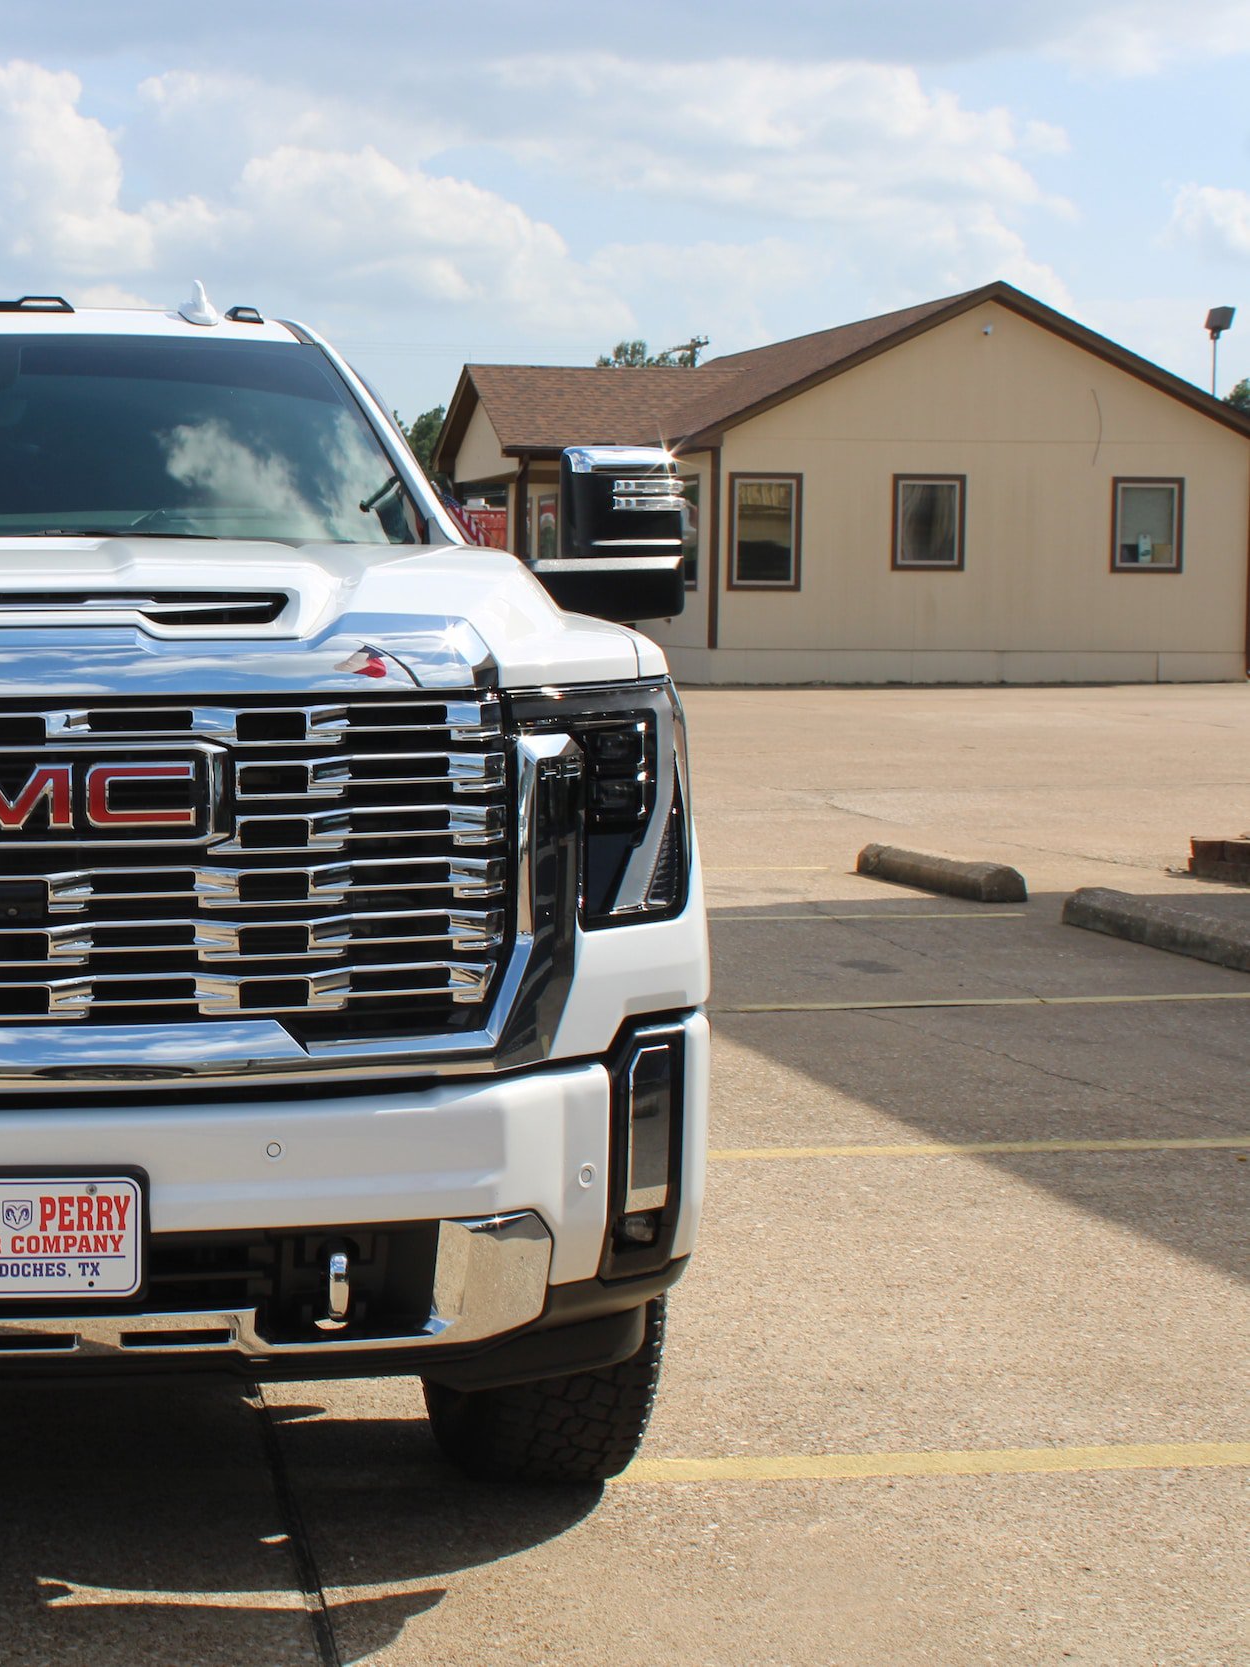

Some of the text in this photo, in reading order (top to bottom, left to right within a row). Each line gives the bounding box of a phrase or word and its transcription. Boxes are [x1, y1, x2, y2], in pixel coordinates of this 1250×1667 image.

[39, 1195, 131, 1232] PERRY
[10, 1234, 124, 1254] COMPANY
[78, 1262, 101, 1277] TX
